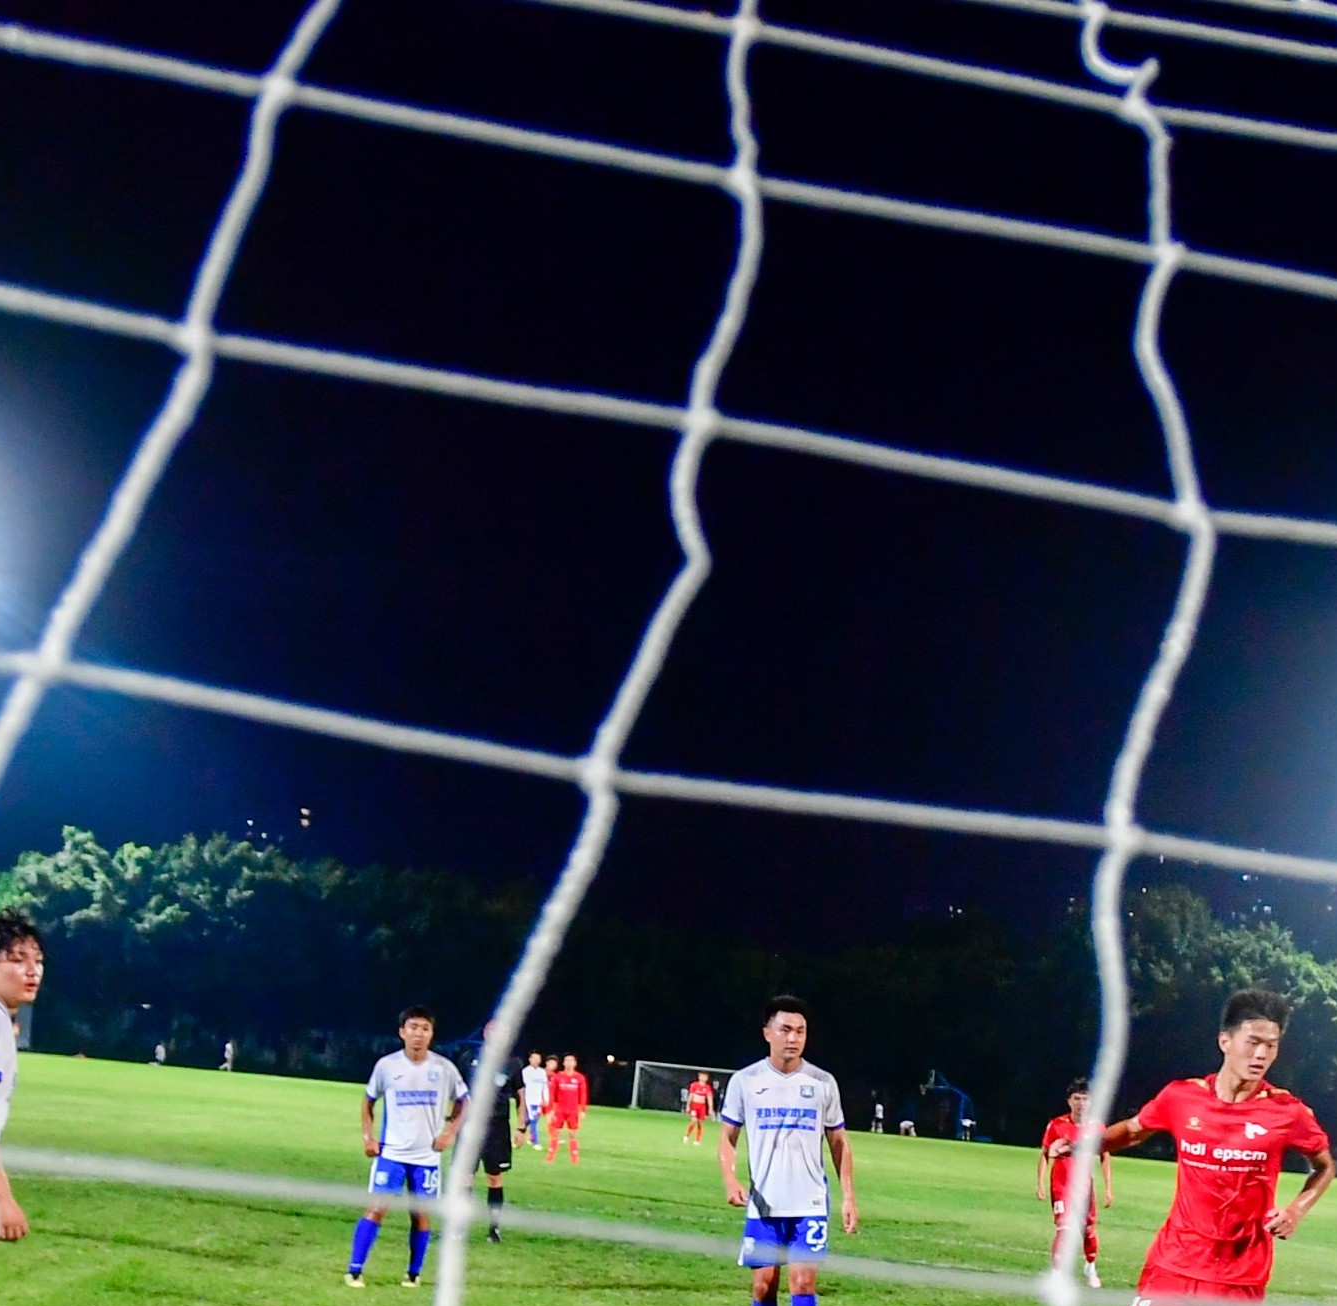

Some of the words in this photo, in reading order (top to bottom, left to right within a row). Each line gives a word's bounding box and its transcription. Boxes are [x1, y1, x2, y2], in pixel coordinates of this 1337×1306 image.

[1180, 1139, 1207, 1157] hdl
[1212, 1147, 1268, 1162] epscm
[805, 1220, 828, 1246] 23
